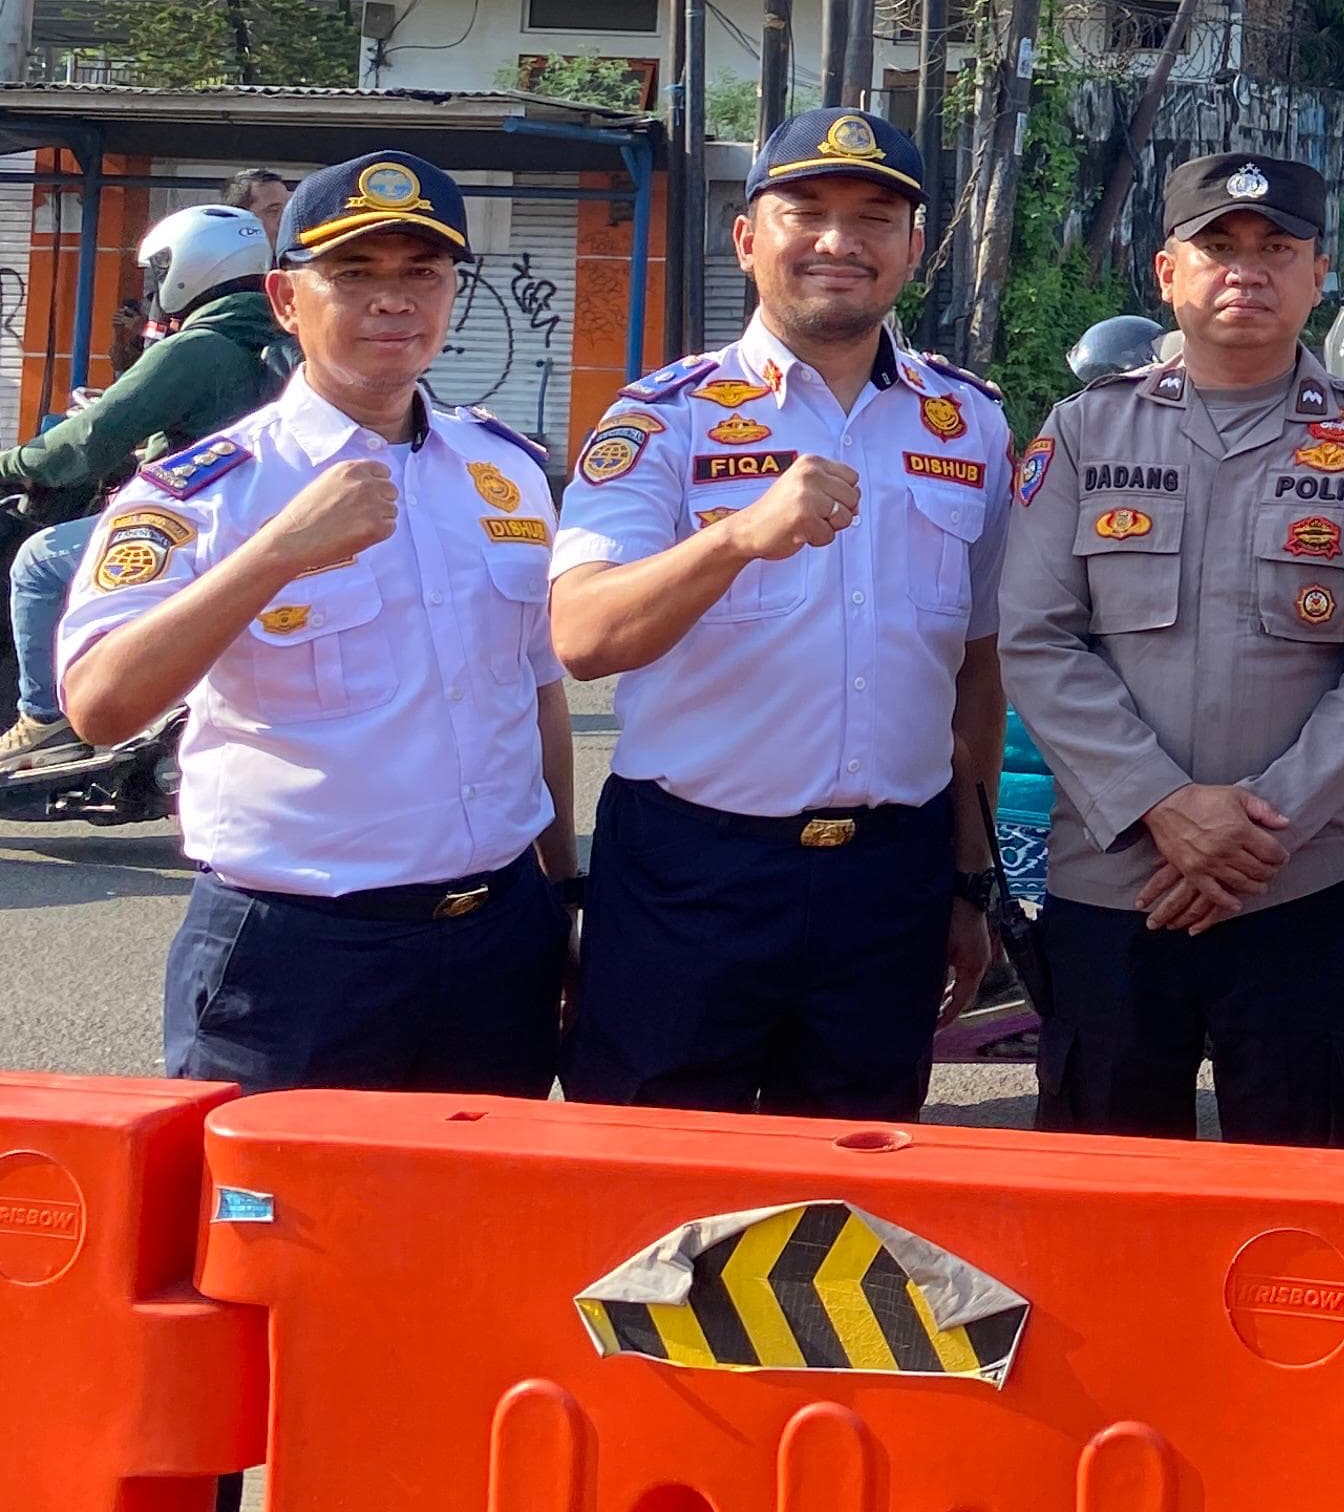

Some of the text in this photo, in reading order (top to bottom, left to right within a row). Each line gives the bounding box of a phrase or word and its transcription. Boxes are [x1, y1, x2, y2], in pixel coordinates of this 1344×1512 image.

[710, 455, 779, 477] FIQA
[910, 455, 978, 481] DISHUB
[1085, 464, 1179, 492] DADANG
[1239, 1284, 1344, 1310] KRISBOW
